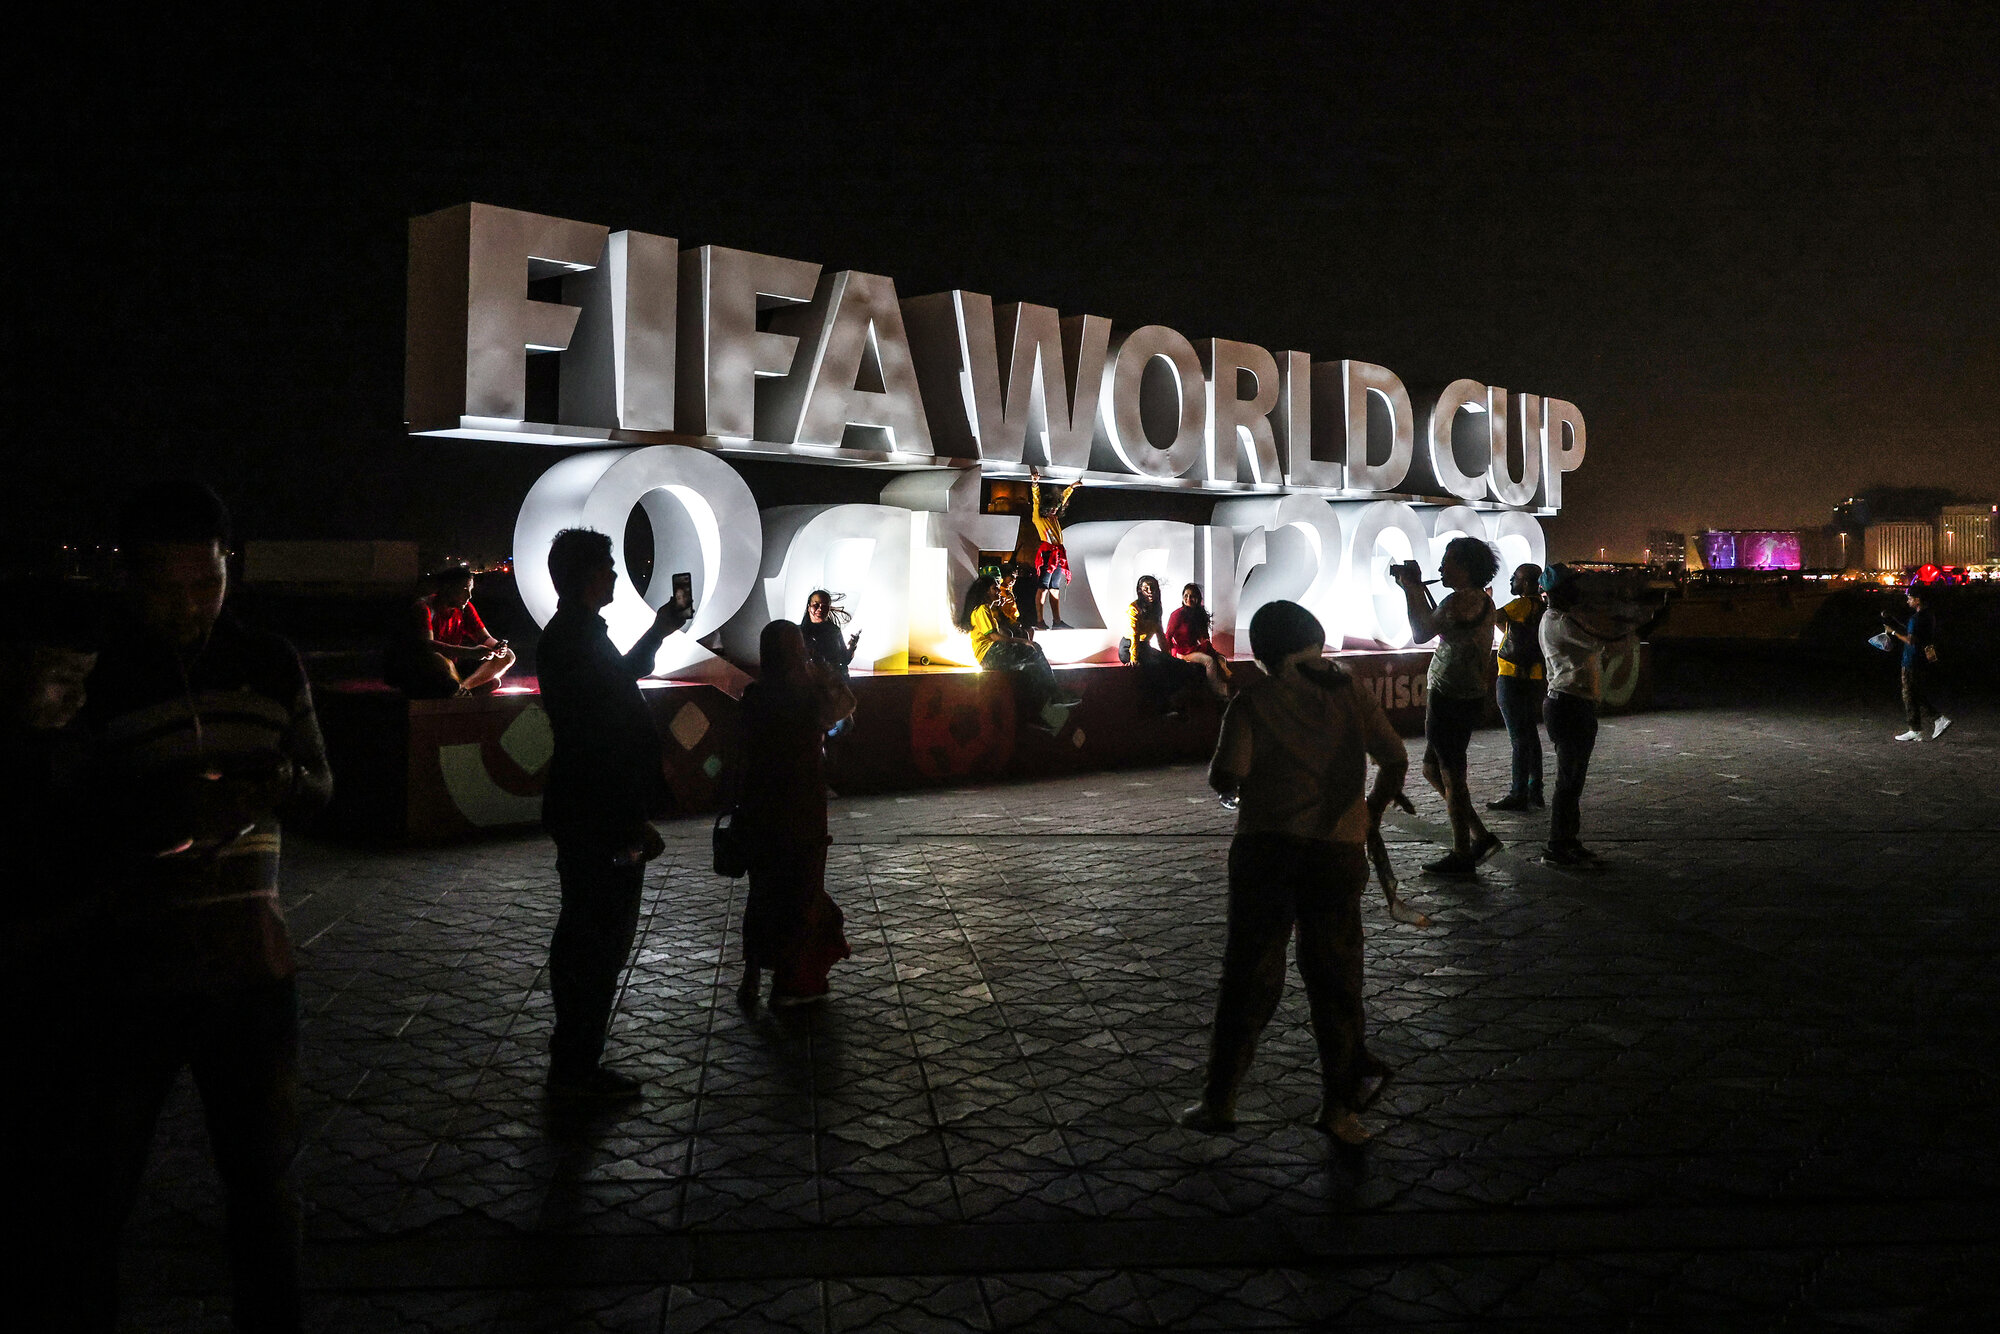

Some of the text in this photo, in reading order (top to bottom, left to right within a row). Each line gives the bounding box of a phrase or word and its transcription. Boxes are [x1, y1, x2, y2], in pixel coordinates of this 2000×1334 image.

[463, 201, 1588, 509] FIFA WORLD CUP
[1274, 493, 1546, 653] 20
